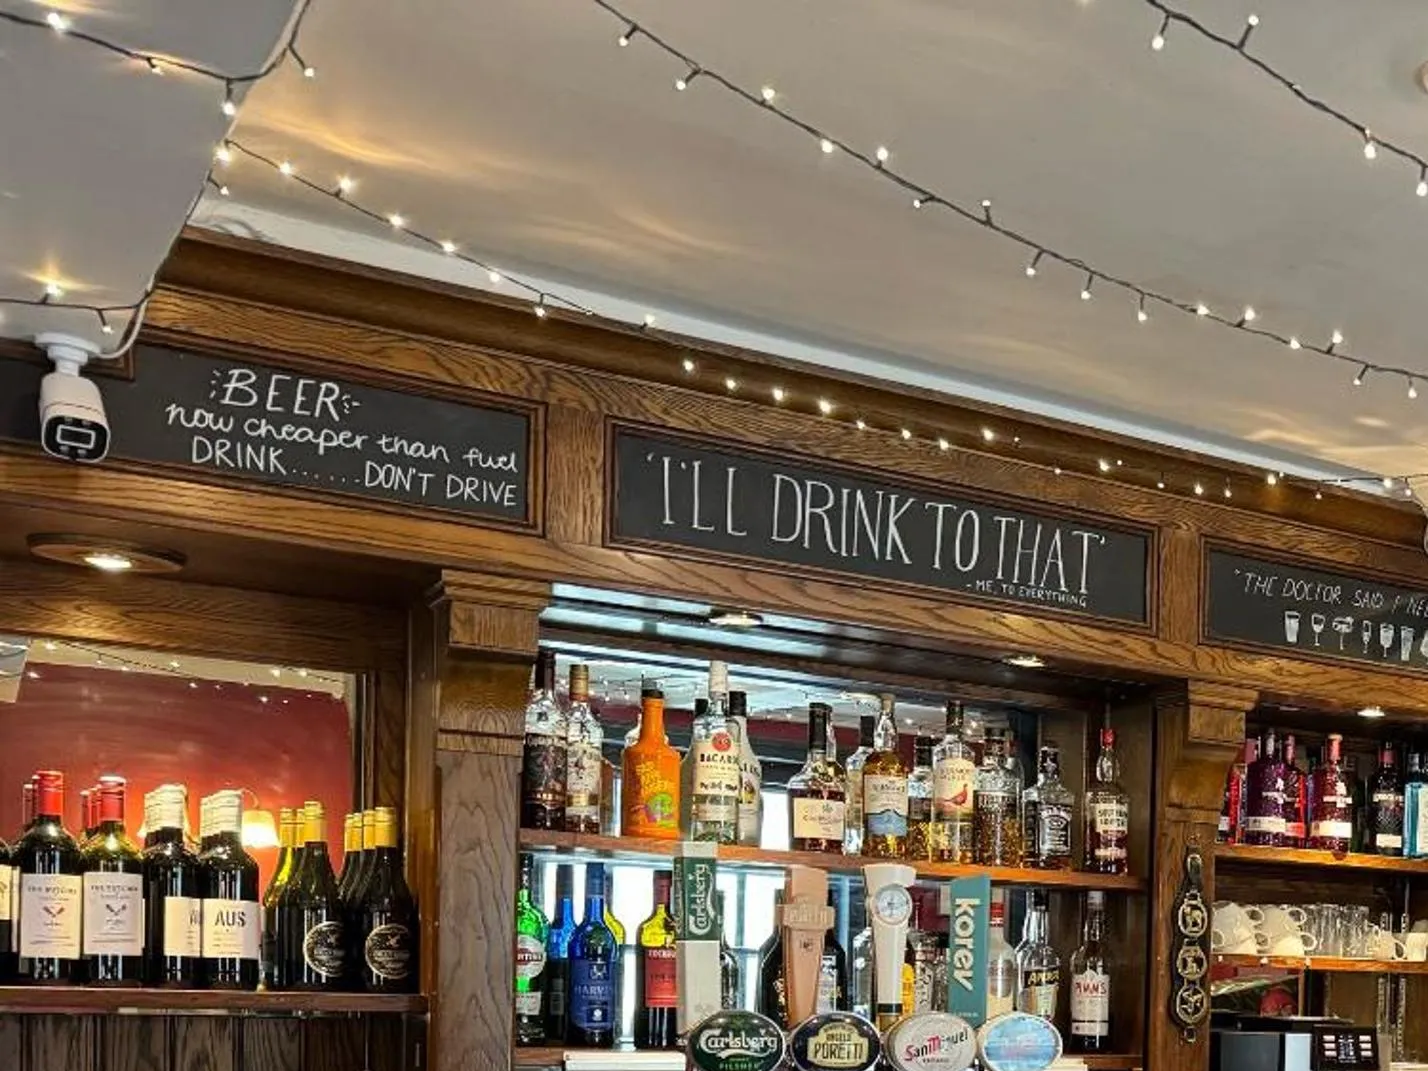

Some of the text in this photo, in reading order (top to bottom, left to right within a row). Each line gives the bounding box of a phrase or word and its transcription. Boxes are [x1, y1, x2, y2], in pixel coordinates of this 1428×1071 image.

[166, 401, 519, 475] now cheaper than fuel
[445, 475, 518, 507] DRIVE
[771, 473, 918, 566] DRINK
[926, 503, 981, 572] TO
[1001, 583, 1016, 595] TO
[1018, 586, 1088, 609] EVERYTHING
[1283, 578, 1343, 605] DOCTOR
[1351, 588, 1385, 610] SAID
[689, 863, 711, 936] Carlsberg
[214, 910, 247, 929] AUS
[699, 1027, 778, 1054] Carlsberg
[813, 1042, 864, 1060] PORETTI
